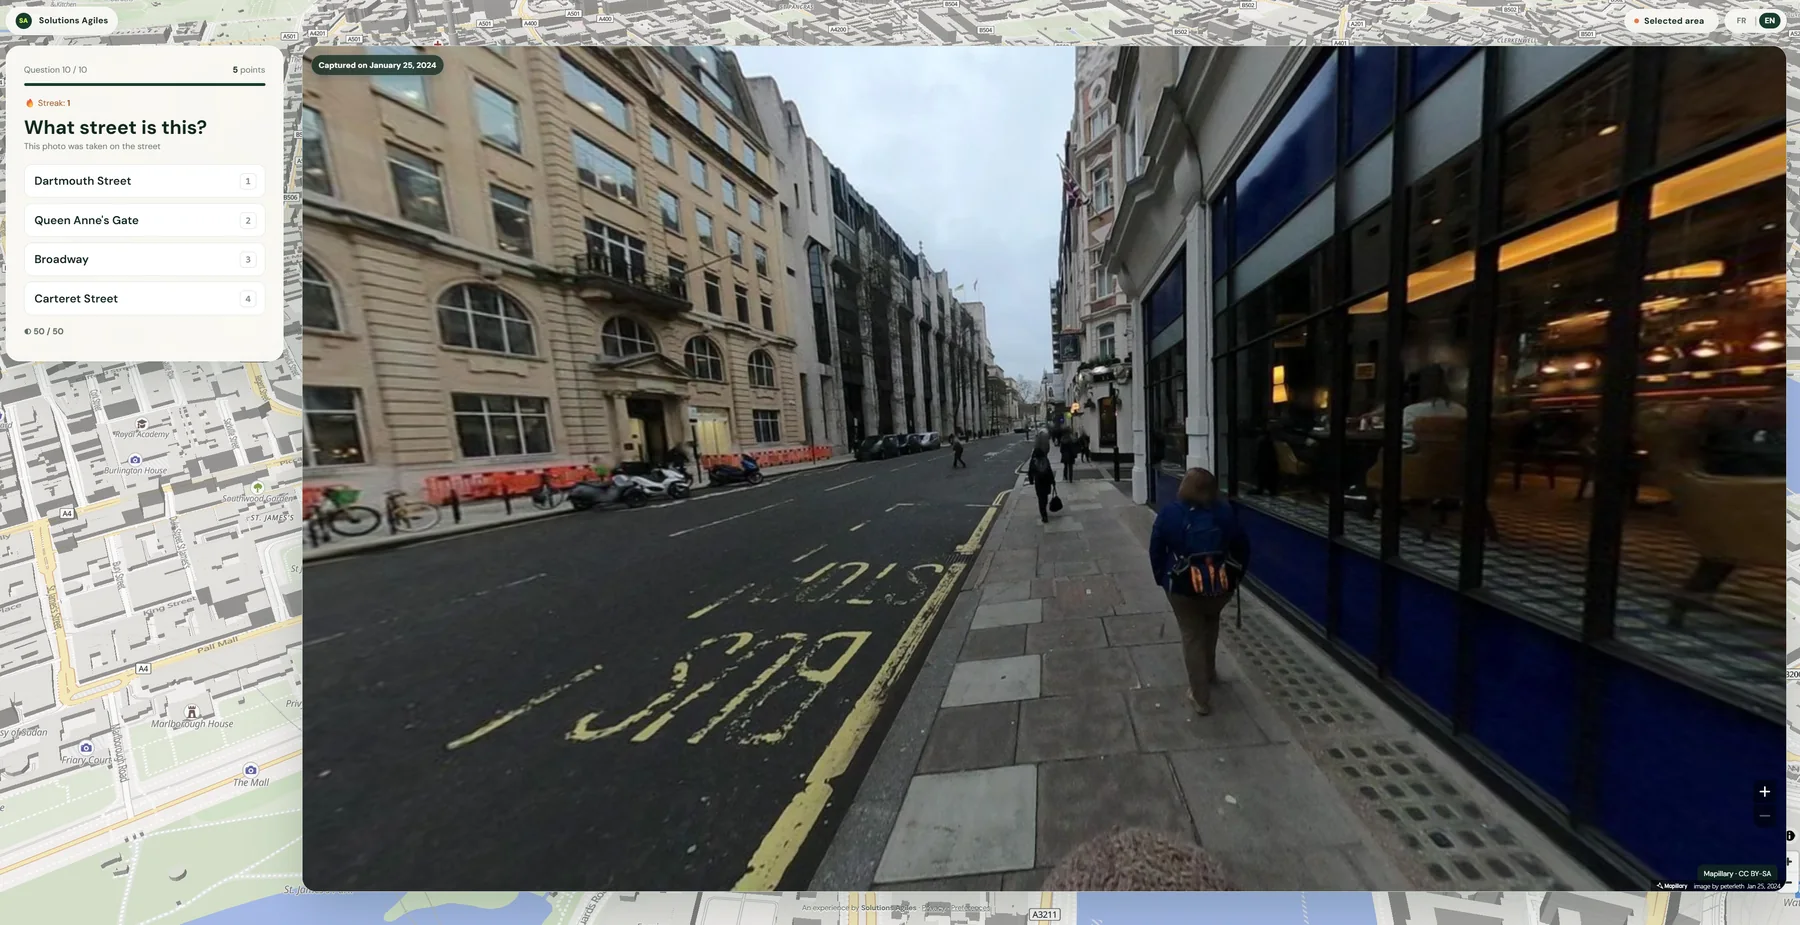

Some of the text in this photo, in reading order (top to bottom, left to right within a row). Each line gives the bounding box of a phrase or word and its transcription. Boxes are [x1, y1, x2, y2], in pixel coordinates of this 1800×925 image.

[82, 17, 108, 26] Agiles
[1645, 16, 1683, 24] Selected
[24, 65, 88, 75] Question 10 / 10
[232, 65, 266, 76] 5 points
[37, 98, 71, 107] Streak: 1
[24, 119, 207, 135] What street is this?
[24, 142, 40, 150] This
[42, 142, 66, 152] photo
[86, 142, 108, 150] taken
[122, 142, 136, 150] the
[34, 176, 132, 186] Dartmouth Street
[245, 177, 251, 185] 1
[34, 214, 139, 227] Queen Anne's Gate
[245, 216, 251, 225] 2
[34, 254, 89, 267] Broadway
[245, 255, 252, 264] 3
[34, 293, 119, 304] Carteret Street
[245, 295, 252, 303] 4
[34, 327, 45, 336] 50
[52, 327, 64, 336] 50
[115, 430, 170, 439] Royal Academy
[104, 466, 142, 476] Burlington
[222, 494, 293, 502] Southwood Garden
[143, 596, 197, 616] King Street
[197, 636, 239, 653] Pall Mall
[564, 629, 873, 746] BUS
[150, 720, 234, 731] Marlborough House
[11, 728, 20, 739] of
[21, 728, 48, 736] Sudan
[111, 723, 130, 783] Marlborough Road
[62, 756, 112, 766] Friary Court
[233, 778, 270, 786] The Mall
[1032, 911, 1057, 919] A3211
